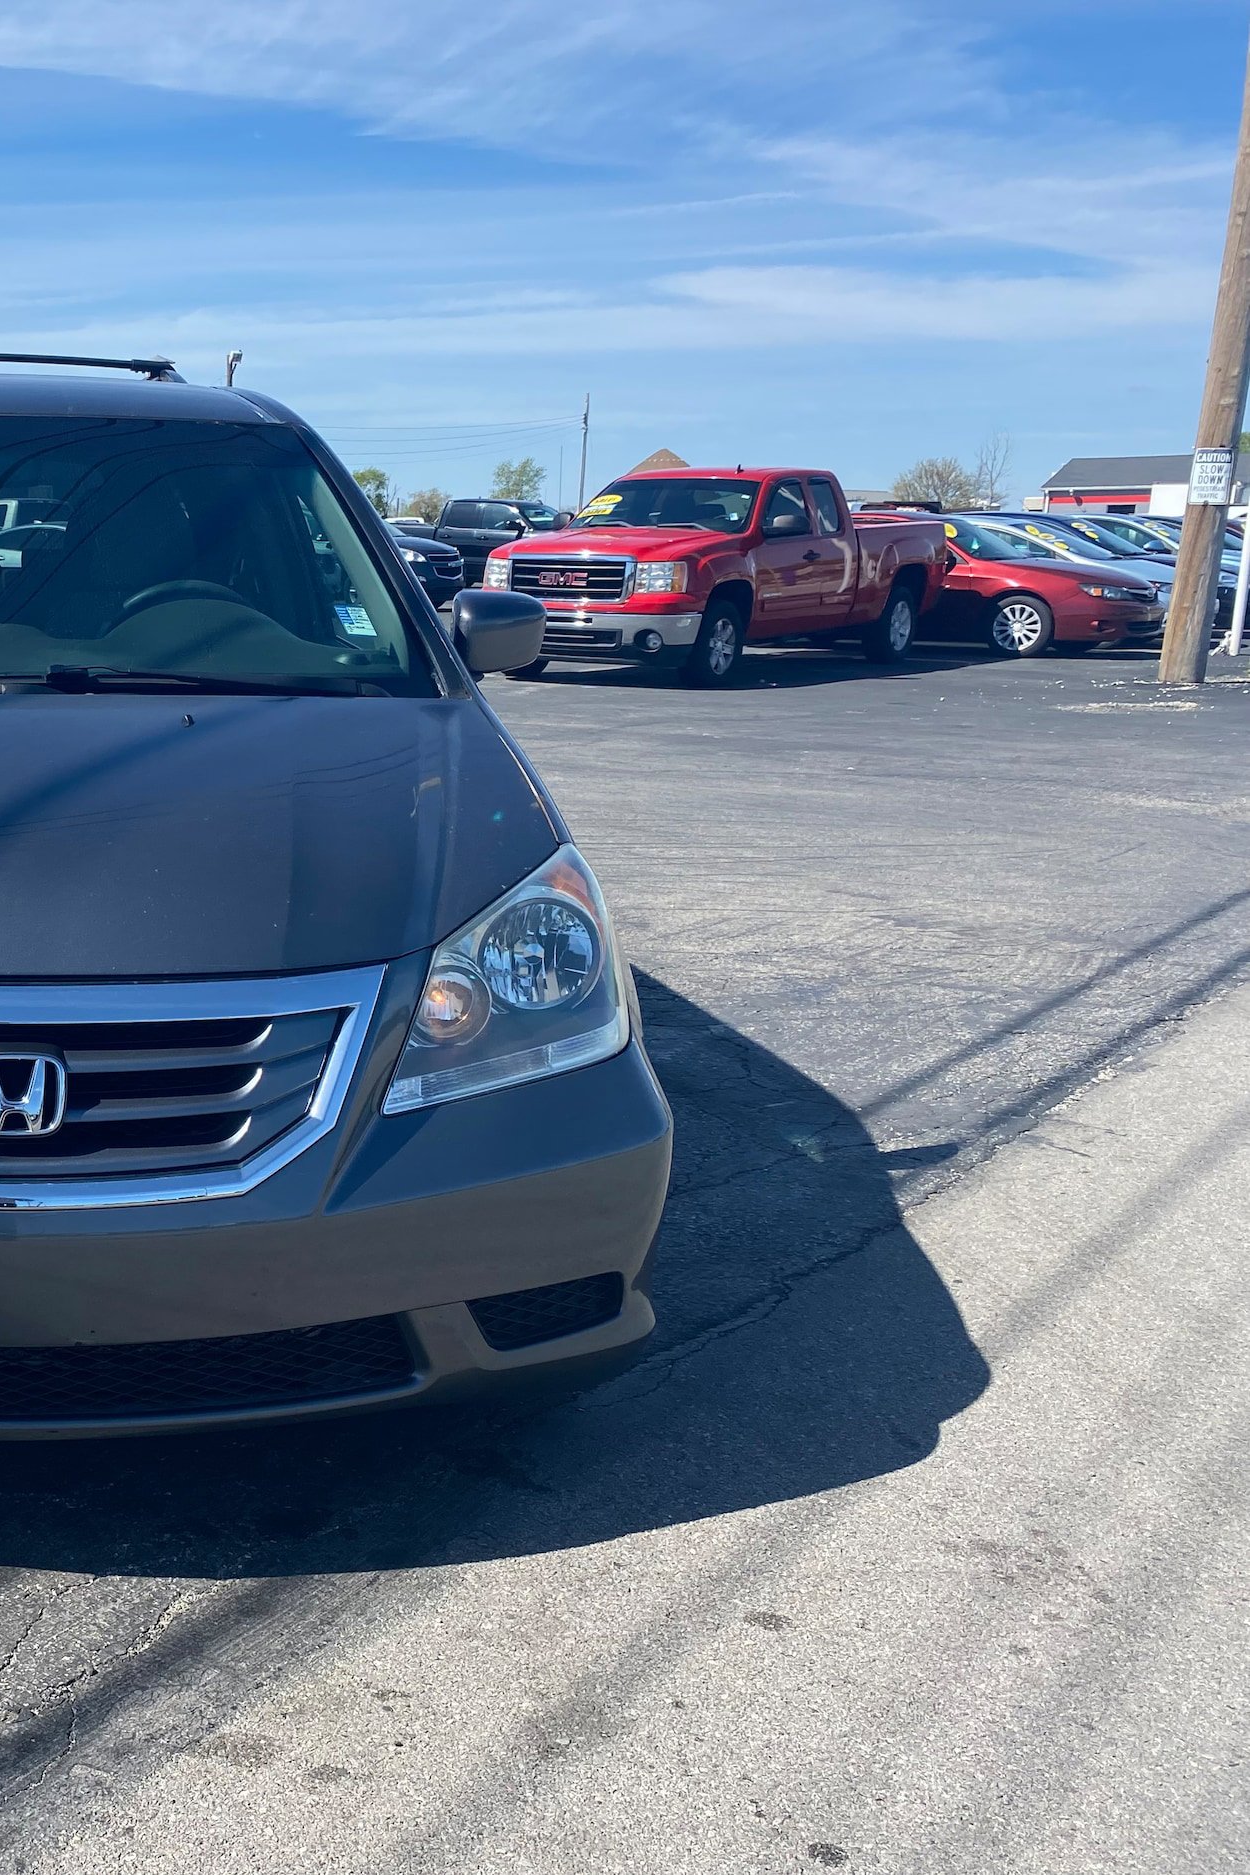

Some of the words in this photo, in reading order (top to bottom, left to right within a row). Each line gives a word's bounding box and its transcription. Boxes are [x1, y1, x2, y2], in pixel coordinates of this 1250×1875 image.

[1196, 452, 1232, 463] CAUTION
[1199, 464, 1225, 475] SLOW
[1197, 474, 1224, 485] DOWN
[538, 571, 589, 587] GMC
